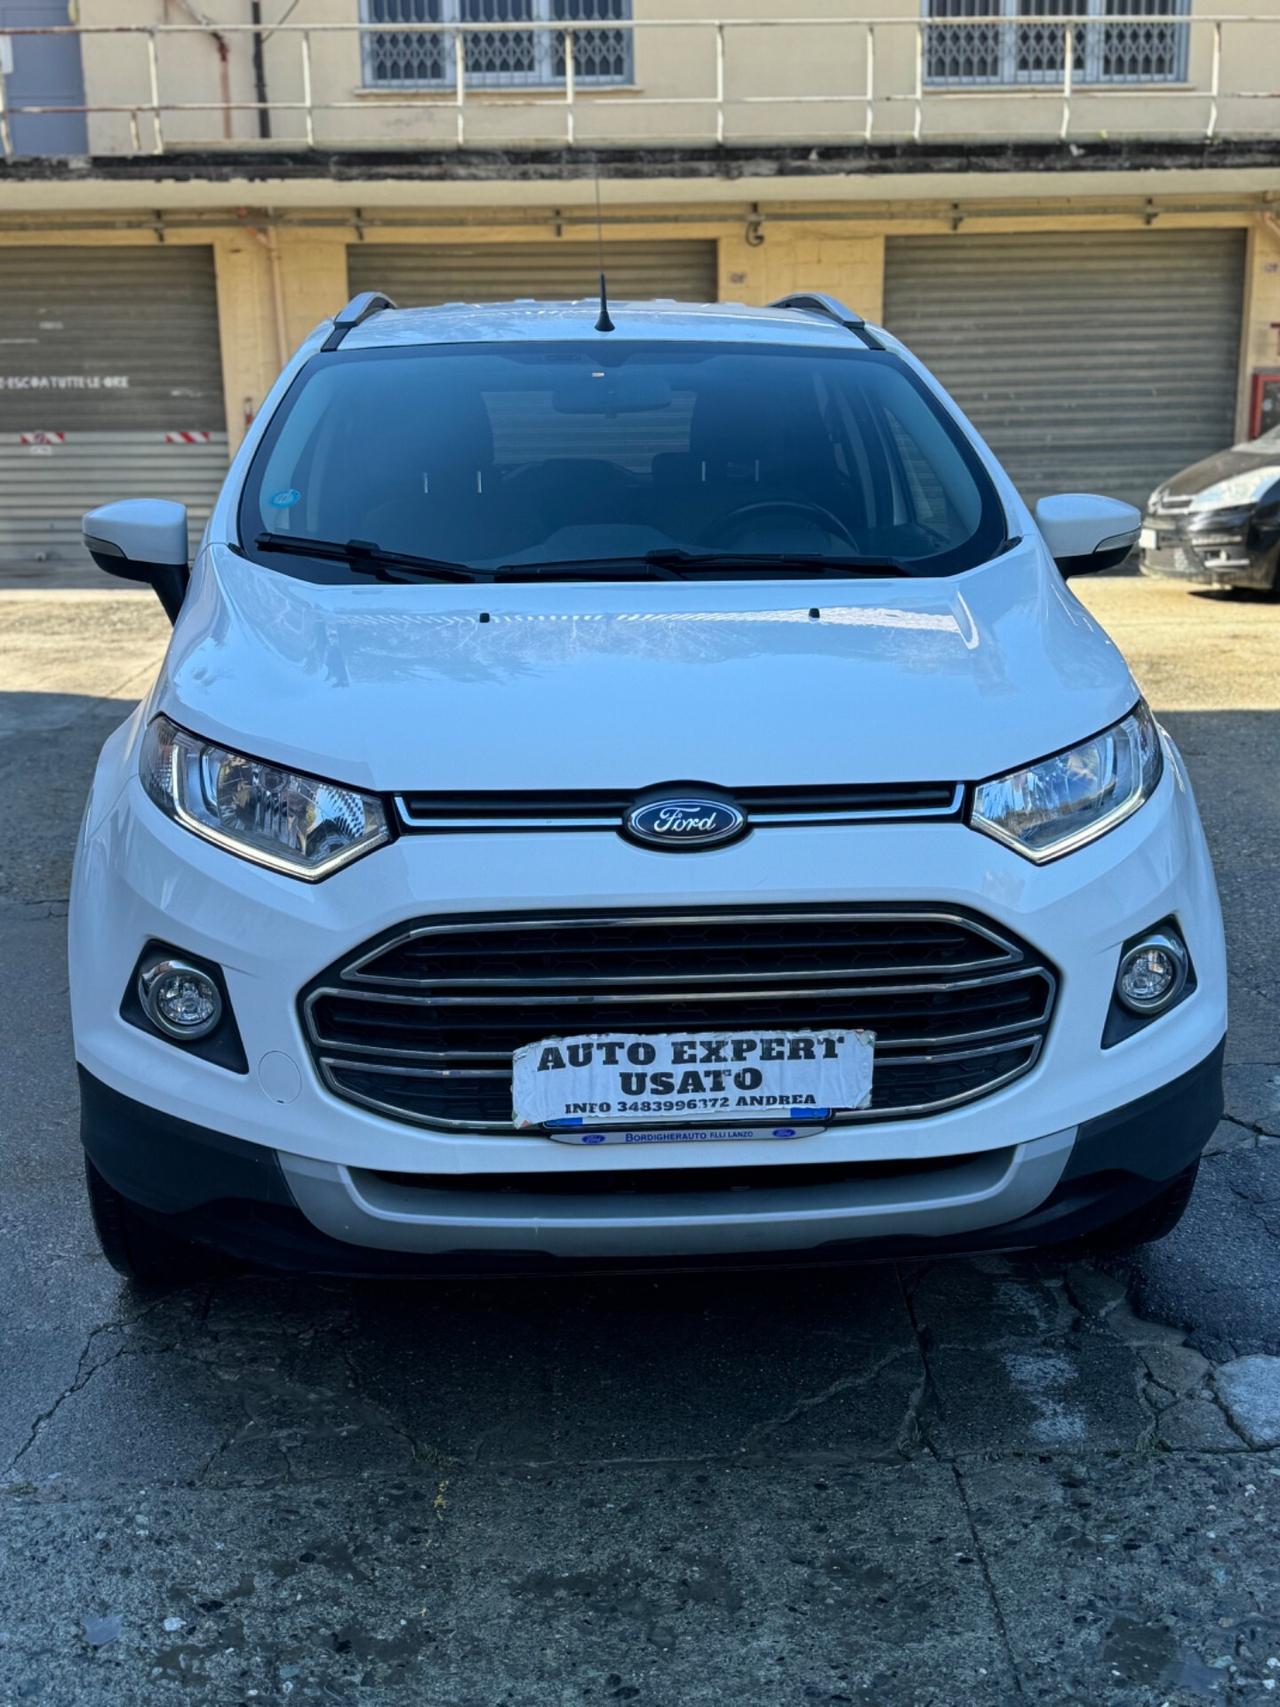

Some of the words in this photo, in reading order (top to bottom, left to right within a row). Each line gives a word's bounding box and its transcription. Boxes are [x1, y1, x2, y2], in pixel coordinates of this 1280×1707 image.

[653, 806, 717, 833] Ford
[537, 1042, 657, 1072] AUTO
[671, 1036, 845, 1065] EXPERT
[619, 1067, 763, 1096] USATO
[565, 1101, 612, 1115] INFO
[617, 1096, 730, 1113] 3483996372
[735, 1094, 817, 1107] ANDREA
